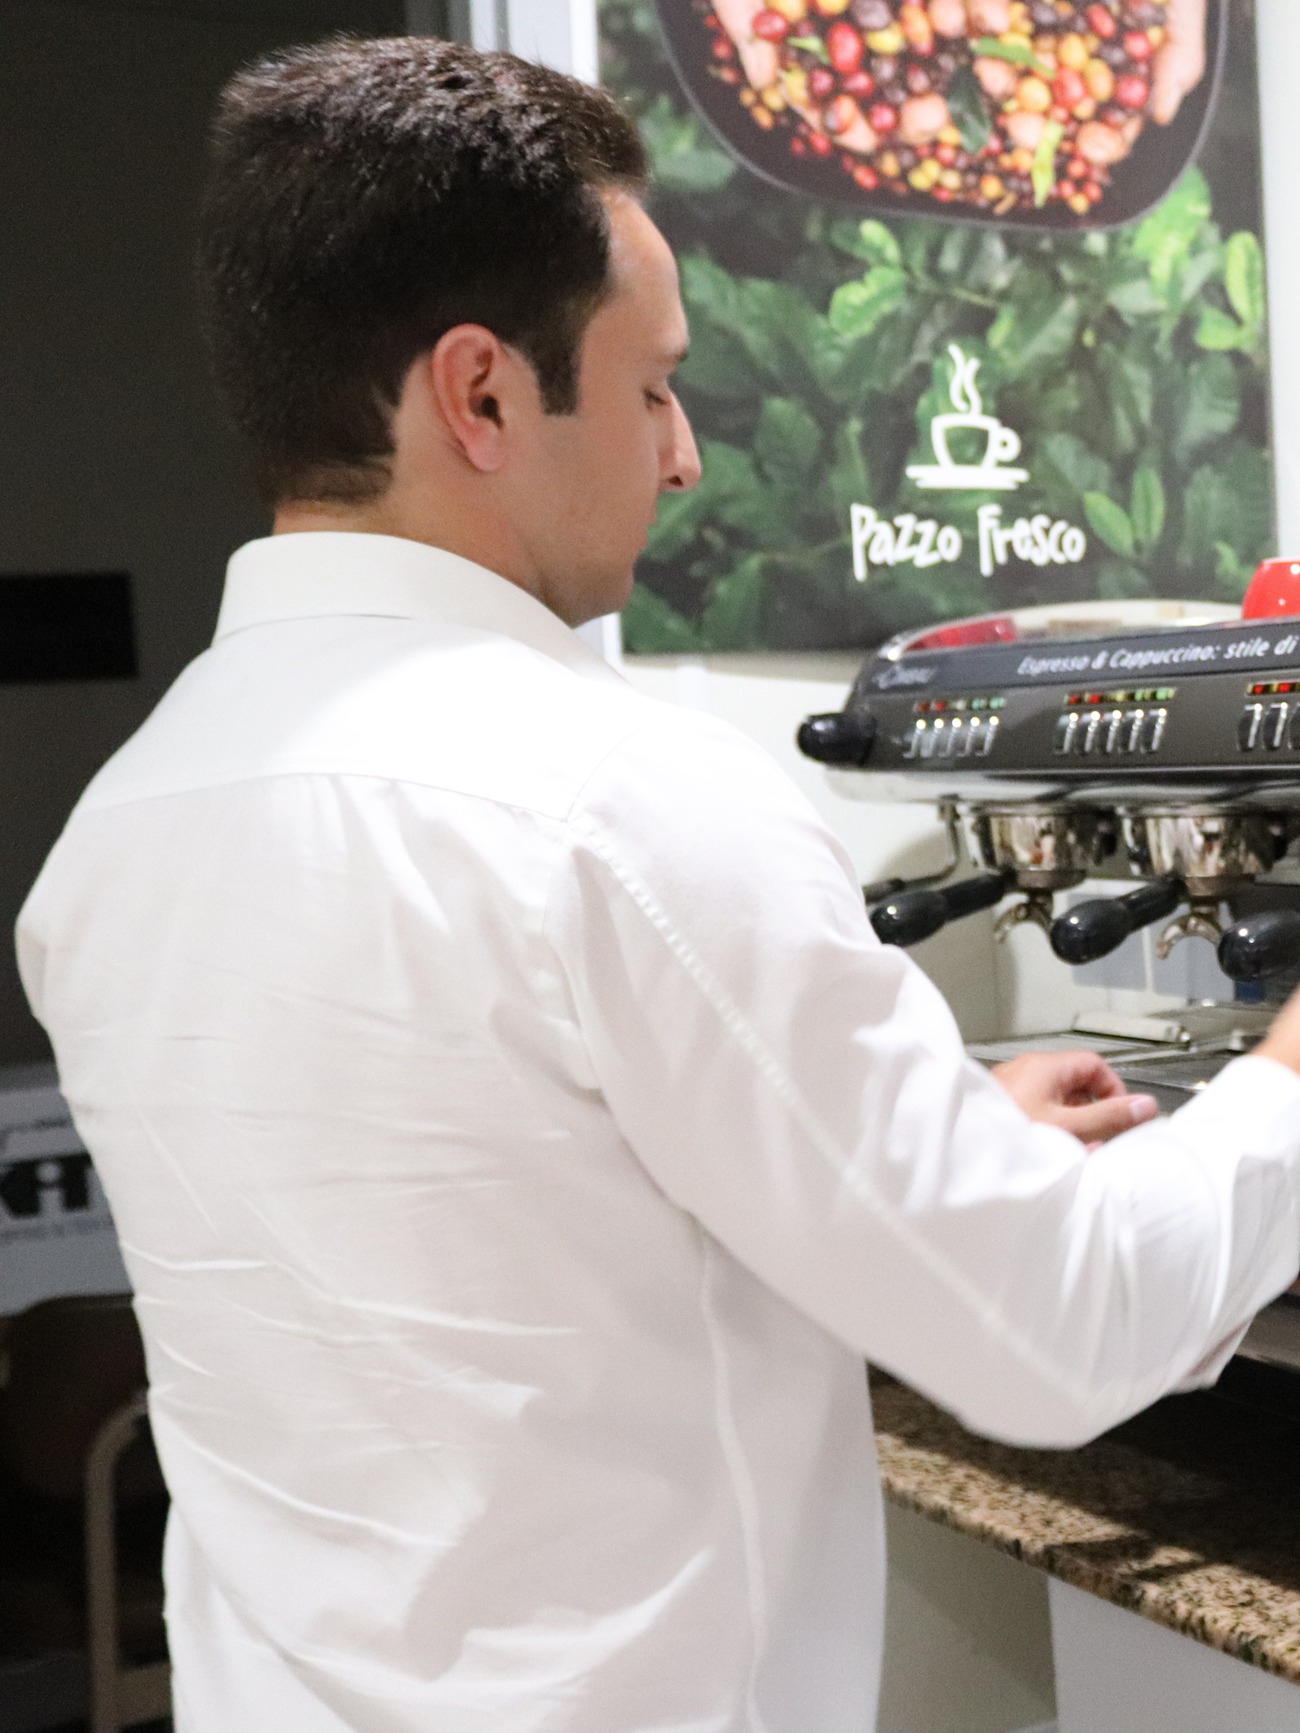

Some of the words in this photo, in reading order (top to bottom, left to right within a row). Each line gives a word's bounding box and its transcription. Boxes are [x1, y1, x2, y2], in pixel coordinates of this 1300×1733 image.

[850, 502, 963, 582] Pazzo
[976, 503, 1087, 577] Fresco
[1017, 655, 1090, 676] Espresso
[1109, 643, 1221, 669] Cappuccino:
[1224, 636, 1270, 659] stile
[1274, 634, 1298, 655] di
